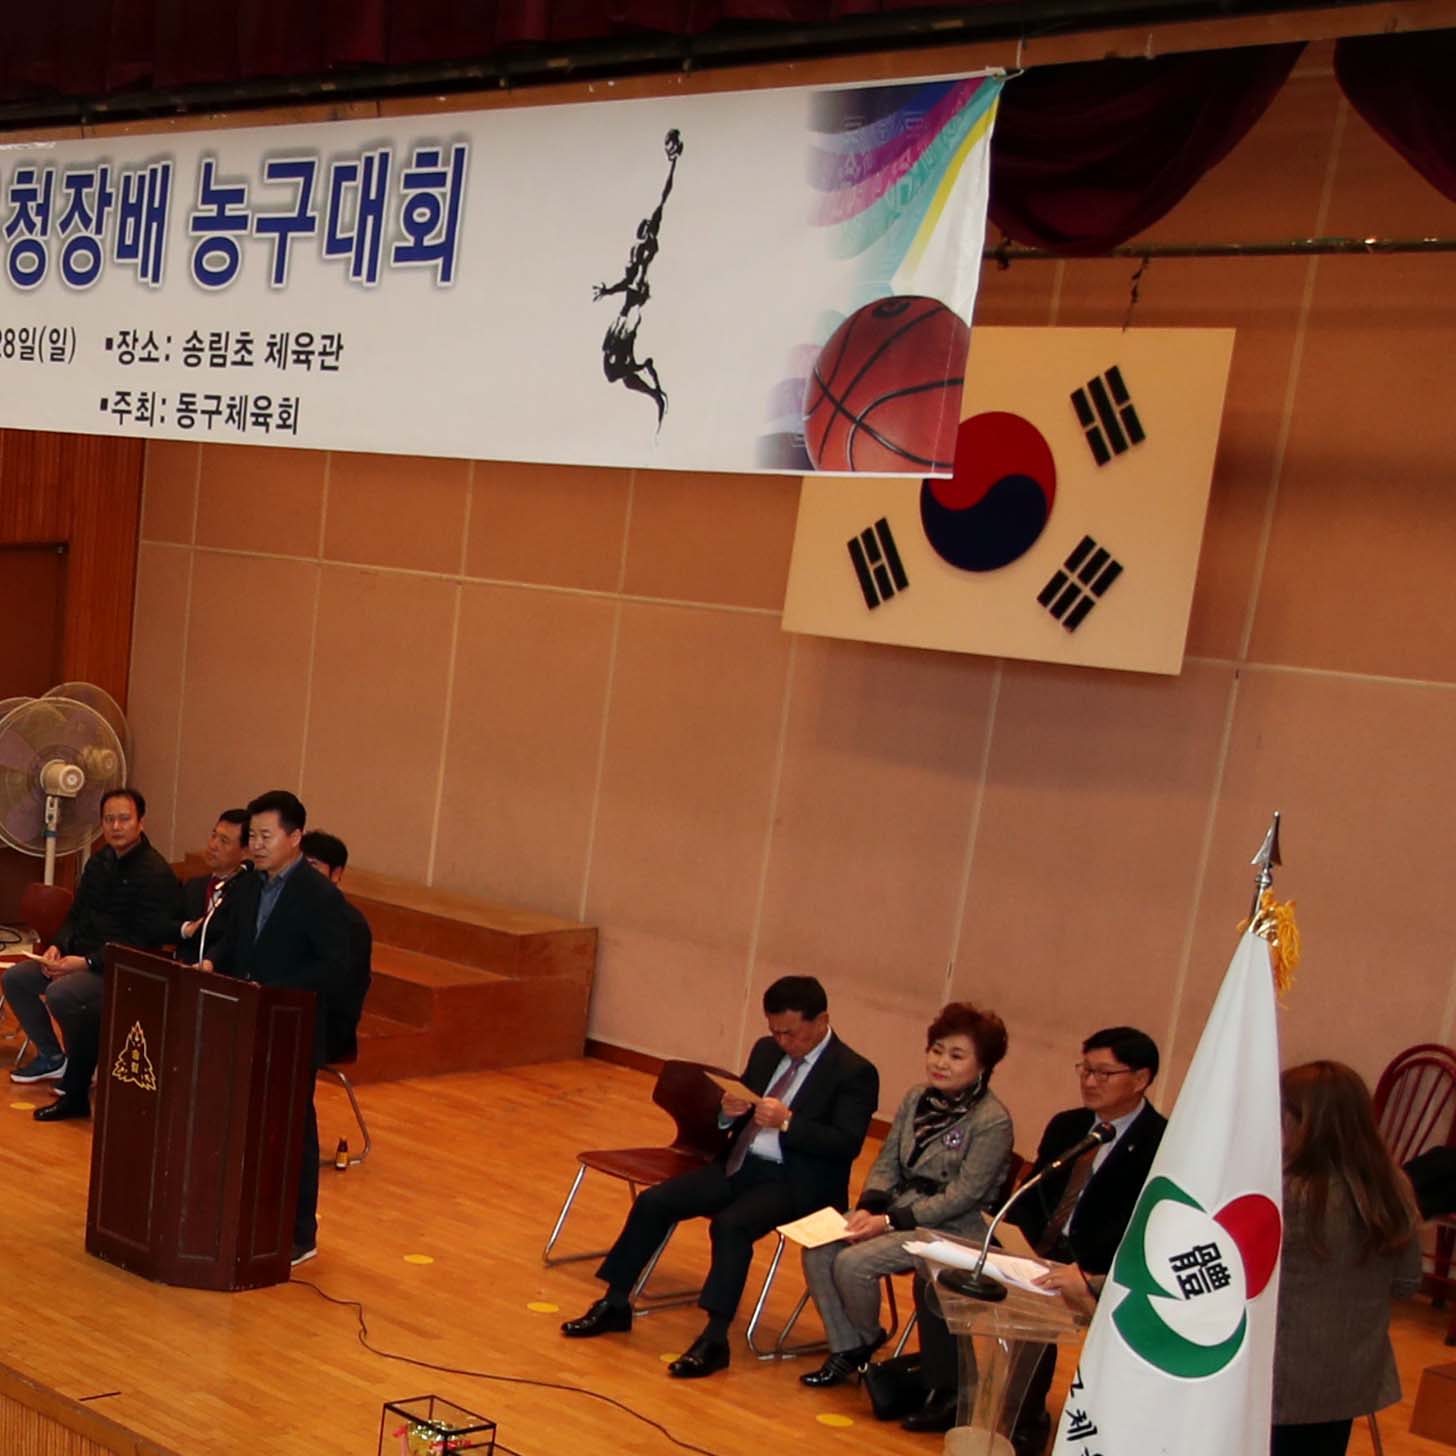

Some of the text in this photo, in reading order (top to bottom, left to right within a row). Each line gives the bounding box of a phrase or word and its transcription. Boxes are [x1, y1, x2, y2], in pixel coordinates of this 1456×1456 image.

[191, 145, 467, 287] 농구대회
[118, 329, 344, 371] 장소: 송림초 체육관
[111, 390, 301, 435] 주최: 동구체육회
